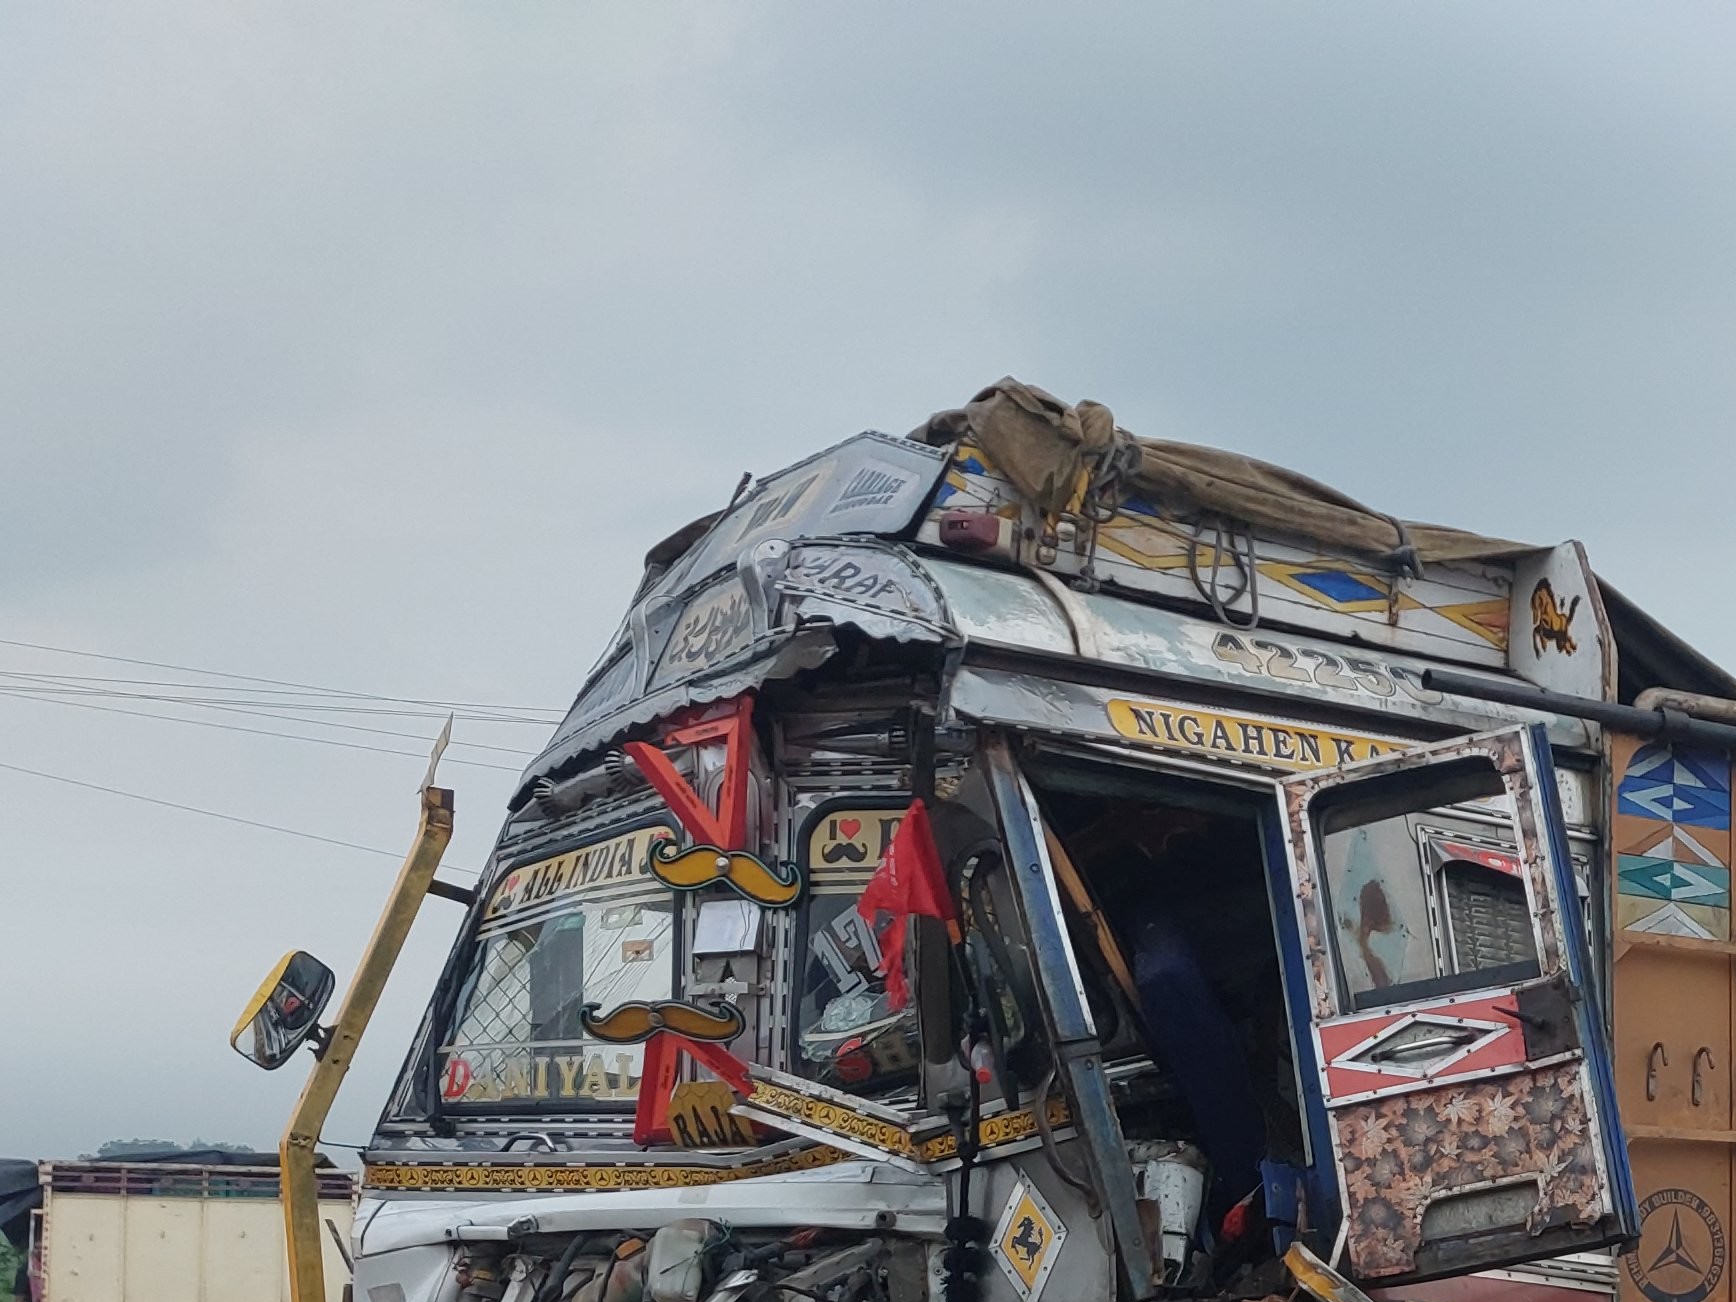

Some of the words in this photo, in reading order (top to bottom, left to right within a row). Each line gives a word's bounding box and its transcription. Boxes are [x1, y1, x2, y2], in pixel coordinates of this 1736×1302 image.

[1129, 707, 1322, 764] NIGAHEN
[829, 819, 837, 840] I
[519, 860, 565, 905] ALL
[565, 836, 637, 889] INDIA
[443, 1053, 641, 1098] DANIYAL
[673, 1105, 751, 1147] RAJA
